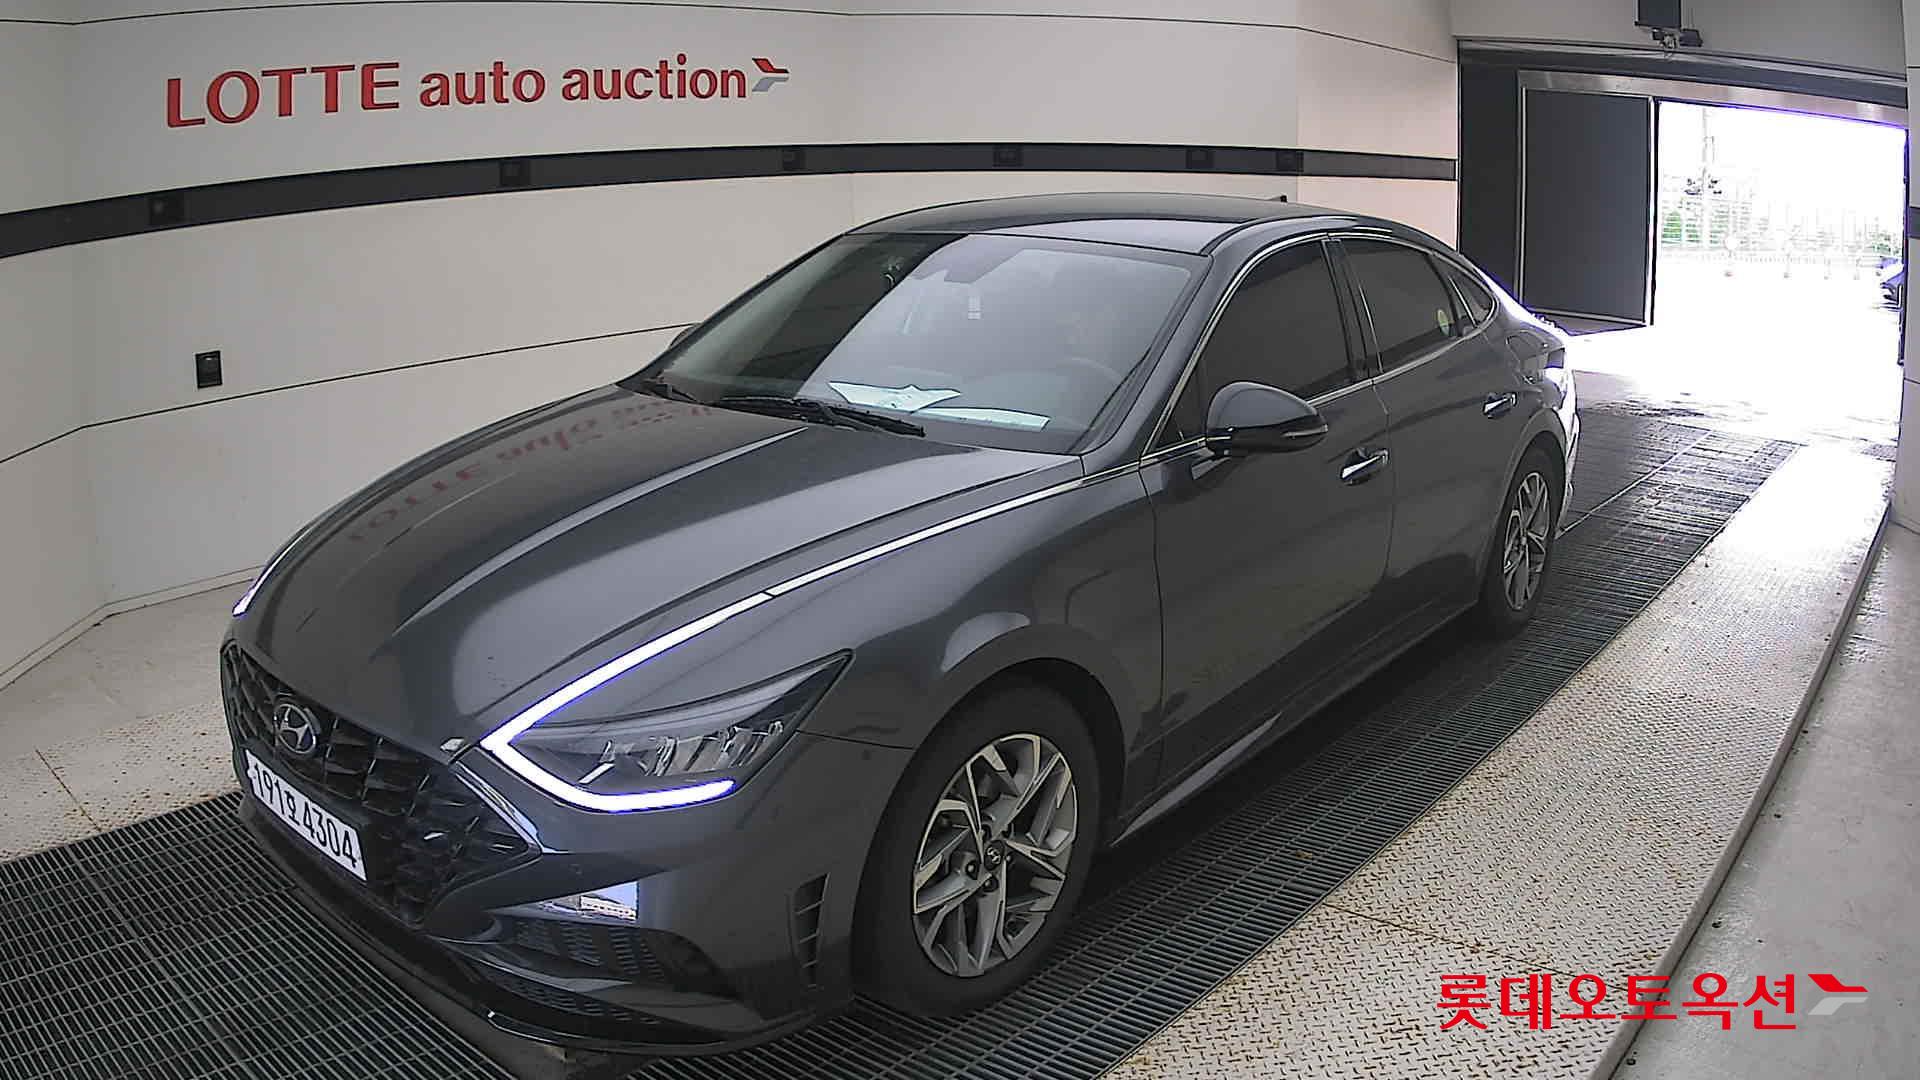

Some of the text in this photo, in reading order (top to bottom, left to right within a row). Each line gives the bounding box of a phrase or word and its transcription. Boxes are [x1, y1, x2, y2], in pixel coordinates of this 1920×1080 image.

[166, 53, 746, 128] LOTTE auto auction
[254, 762, 358, 868] 191호 4304
